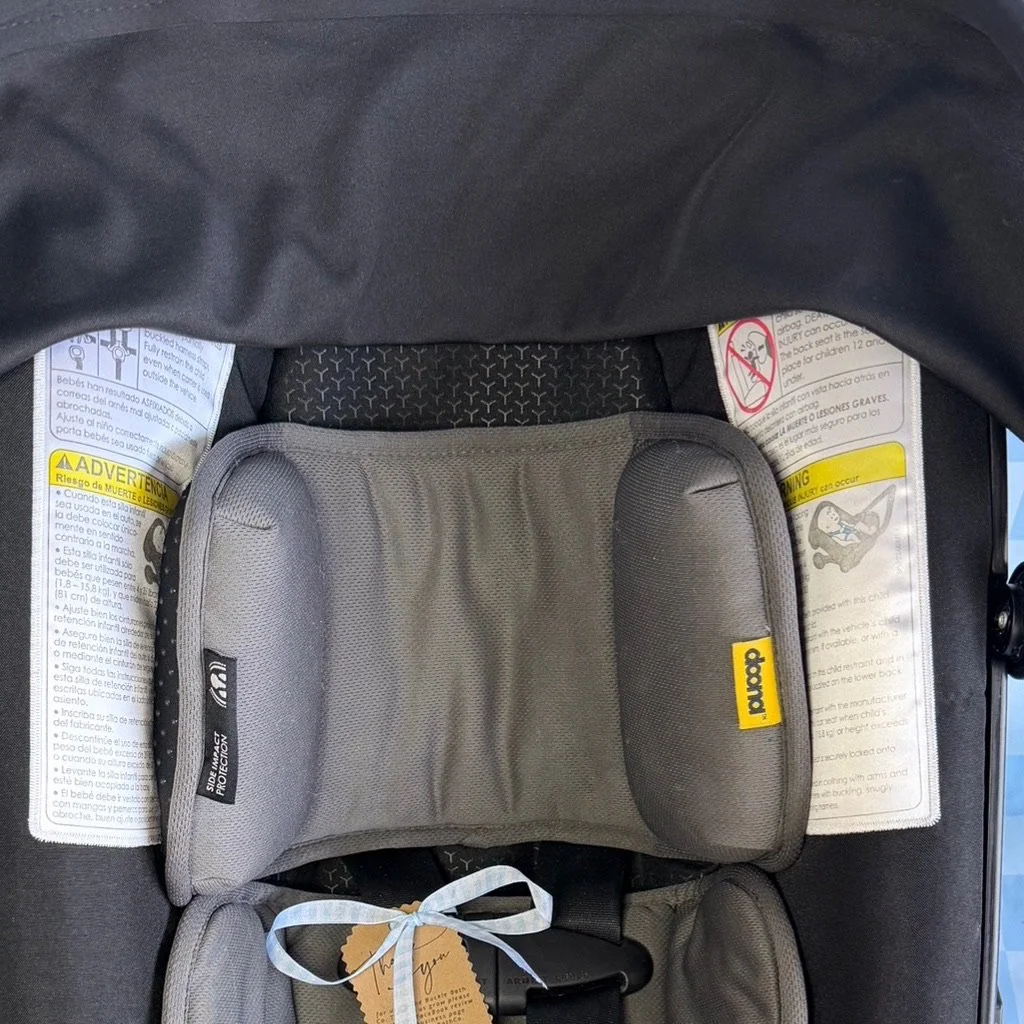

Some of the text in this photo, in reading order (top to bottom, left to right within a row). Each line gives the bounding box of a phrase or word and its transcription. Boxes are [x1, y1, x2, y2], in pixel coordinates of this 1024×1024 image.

[852, 340, 864, 350] 12
[56, 375, 86, 389] Bebés
[827, 378, 853, 392] hacia
[878, 369, 890, 378] en
[56, 389, 92, 403] correas
[92, 394, 108, 406] del
[817, 403, 851, 420] LESIONES
[852, 393, 890, 409] GRAVES.
[56, 401, 113, 422] abrochadas.
[56, 412, 114, 434] Ajuste al niño
[846, 412, 865, 425] para
[865, 407, 881, 417] los
[56, 424, 126, 449] porta bebés sea
[56, 473, 90, 488] Riesgo
[105, 483, 137, 500] MUERTE
[76, 456, 170, 502] ADVERTENCIA
[781, 470, 811, 497] RNING
[744, 648, 766, 714] doona
[206, 731, 222, 792] SIDE IMPACT
[215, 734, 228, 796] PROTECTION
[416, 998, 474, 1019] aceBook review
[448, 992, 470, 1004] please
